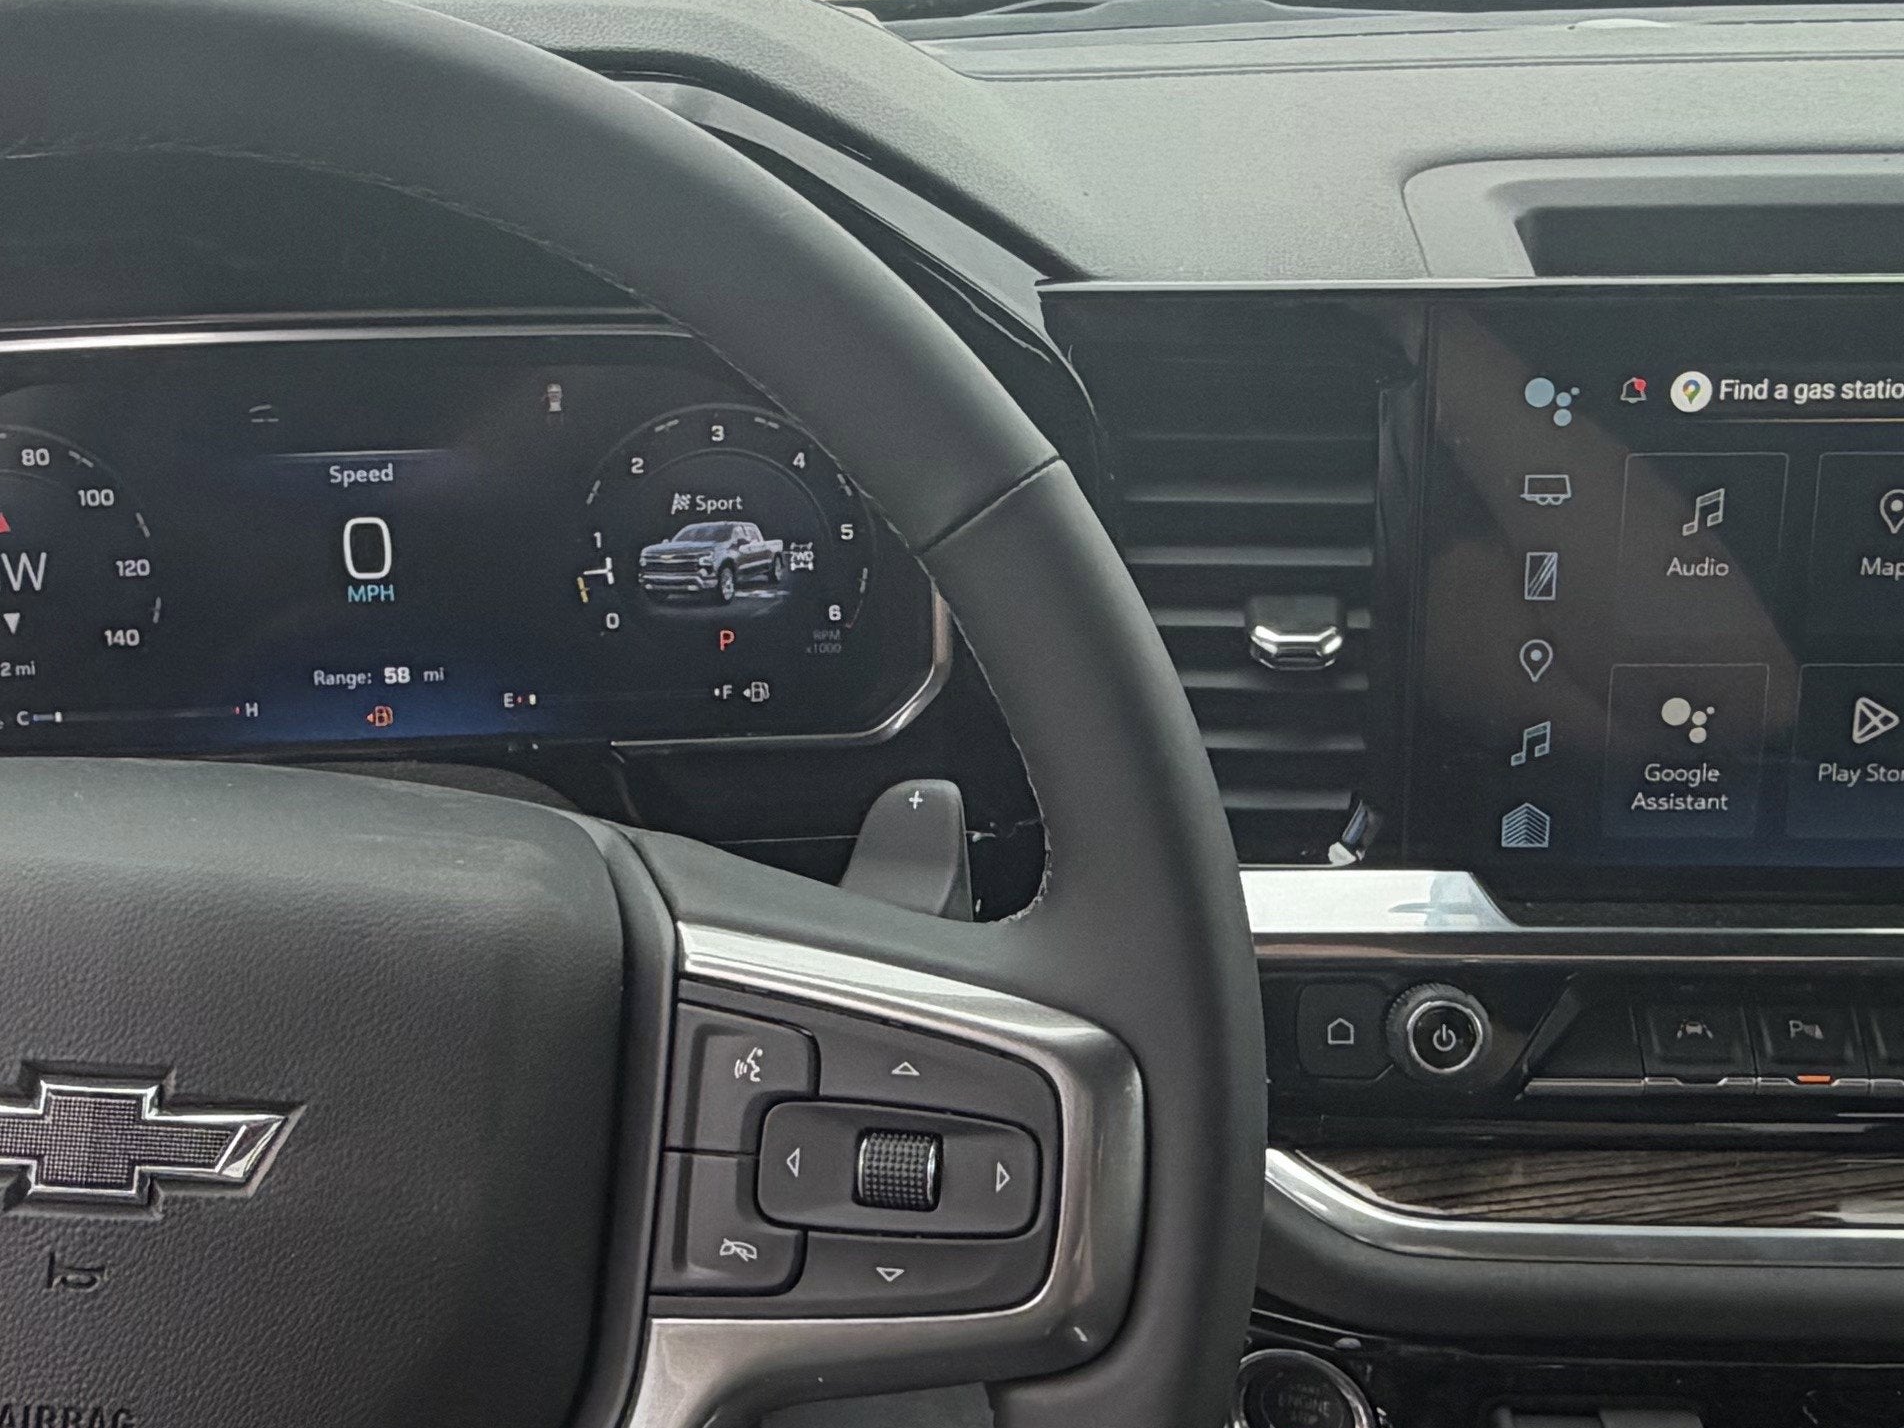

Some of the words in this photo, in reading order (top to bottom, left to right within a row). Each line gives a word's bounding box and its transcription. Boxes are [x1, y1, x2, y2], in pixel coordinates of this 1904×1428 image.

[1719, 380, 1768, 401] Find
[1774, 385, 1789, 401] a
[1794, 383, 1835, 406] gas
[710, 425, 725, 442] 3
[21, 449, 50, 467] 80
[630, 457, 644, 474] 2
[792, 453, 806, 469] 4
[329, 462, 394, 485] Speed
[78, 489, 115, 508] 100
[695, 493, 744, 513] Sport
[592, 532, 603, 549] 1
[840, 524, 854, 541] 5
[342, 516, 393, 580] 0
[116, 560, 150, 577] 120
[1666, 557, 1729, 577] Audio
[346, 584, 395, 603] MPH
[605, 613, 620, 630] 0
[828, 604, 842, 621] 6
[104, 629, 140, 647] 140
[719, 630, 736, 651] P
[0, 661, 12, 677] 2
[15, 660, 36, 676] mi
[313, 669, 372, 689] Range:
[383, 666, 411, 685] 58
[423, 667, 445, 683] mi
[503, 692, 514, 708] E
[722, 684, 734, 700] F
[16, 710, 30, 726] C
[245, 703, 259, 718] H
[1644, 762, 1721, 786] Google
[1817, 763, 1860, 786] Play
[1630, 793, 1729, 812] Assistant
